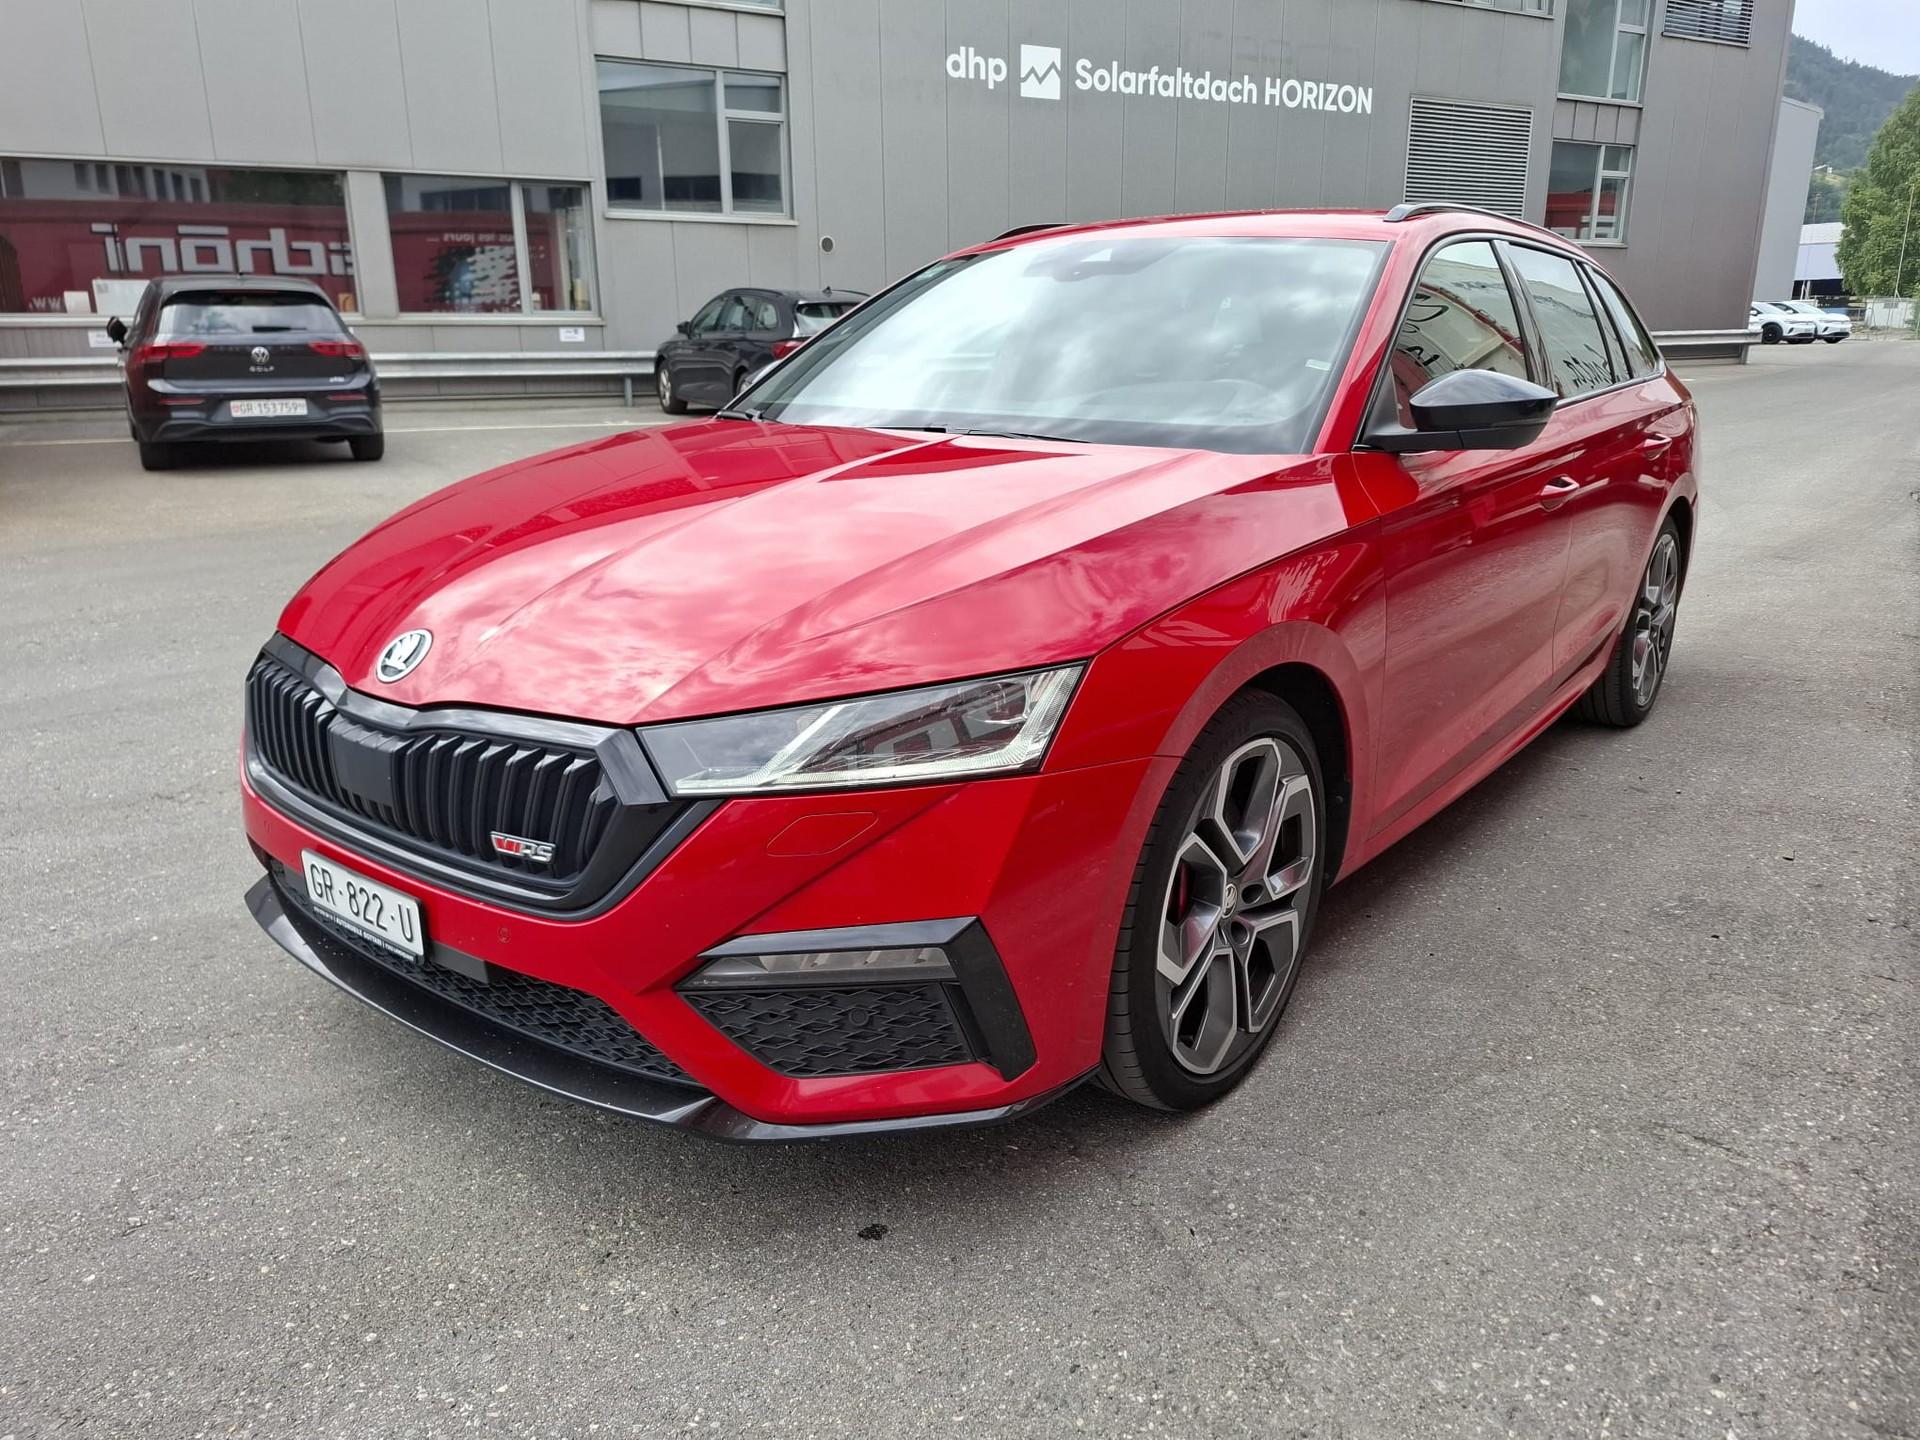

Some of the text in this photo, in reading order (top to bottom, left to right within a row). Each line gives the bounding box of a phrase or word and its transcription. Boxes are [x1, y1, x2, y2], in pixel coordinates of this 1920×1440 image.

[946, 46, 1373, 114] dhp Solarfaltdach HORIZON
